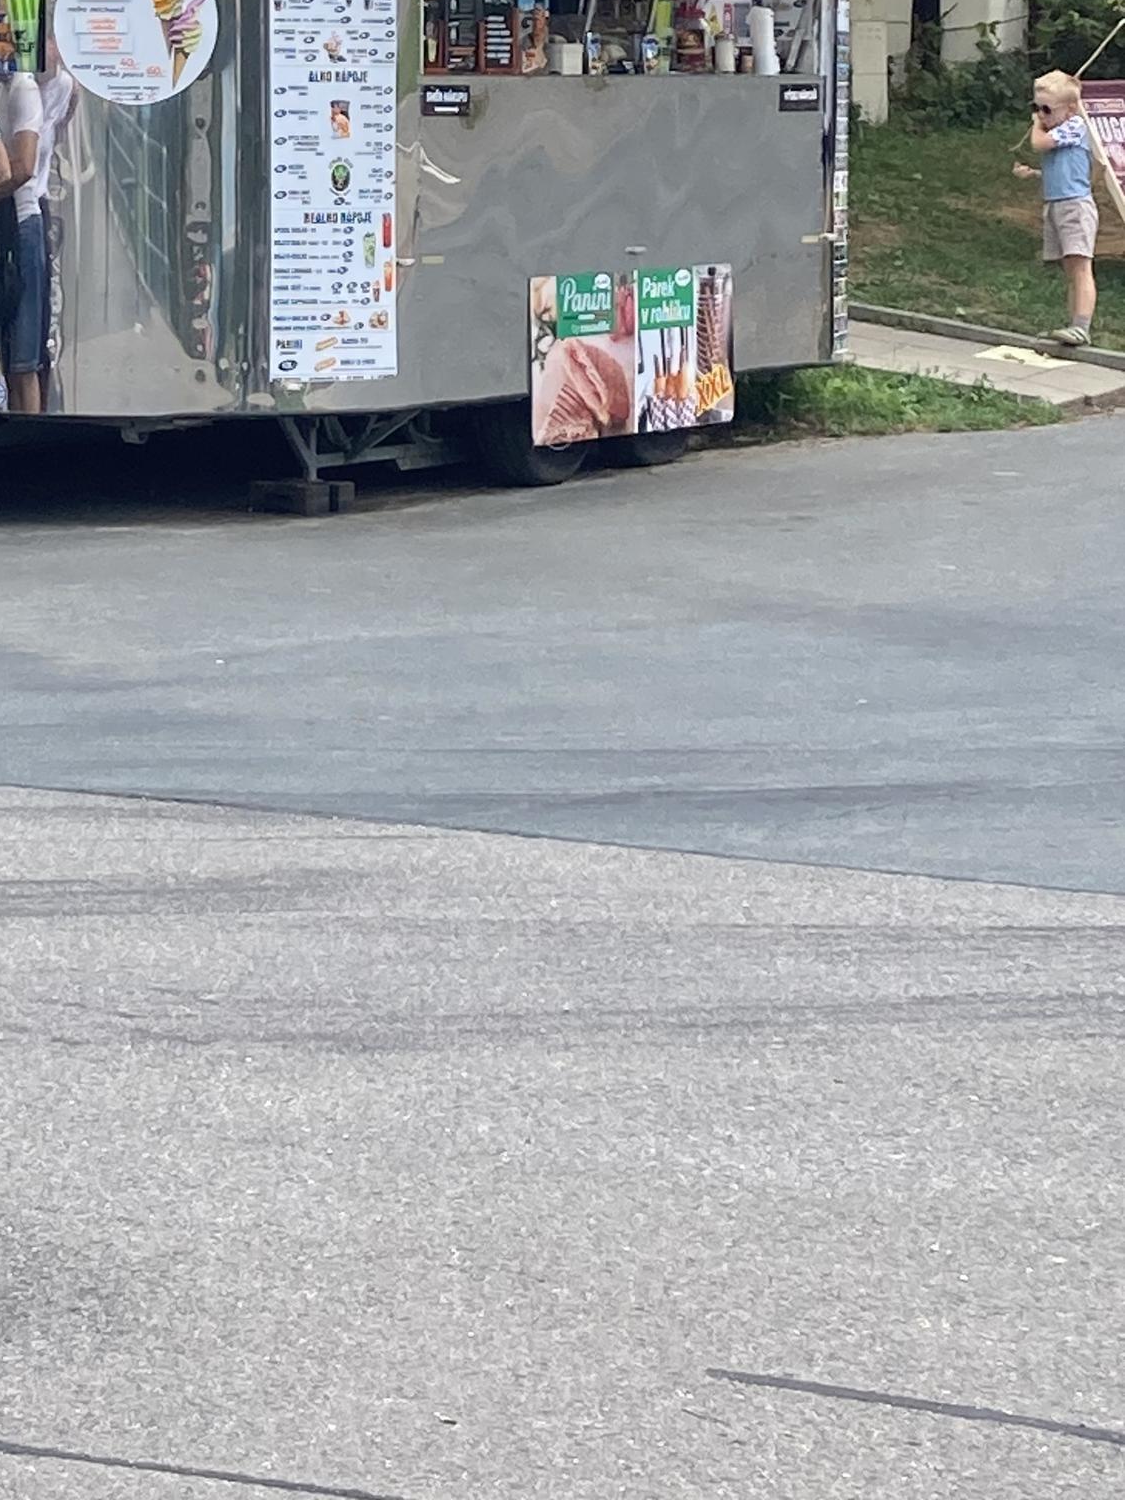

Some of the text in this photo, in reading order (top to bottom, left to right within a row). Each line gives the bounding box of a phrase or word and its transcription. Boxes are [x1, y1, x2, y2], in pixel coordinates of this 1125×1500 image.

[560, 277, 611, 313] Panini
[642, 275, 676, 299] Párek
[695, 370, 731, 412] XXL
